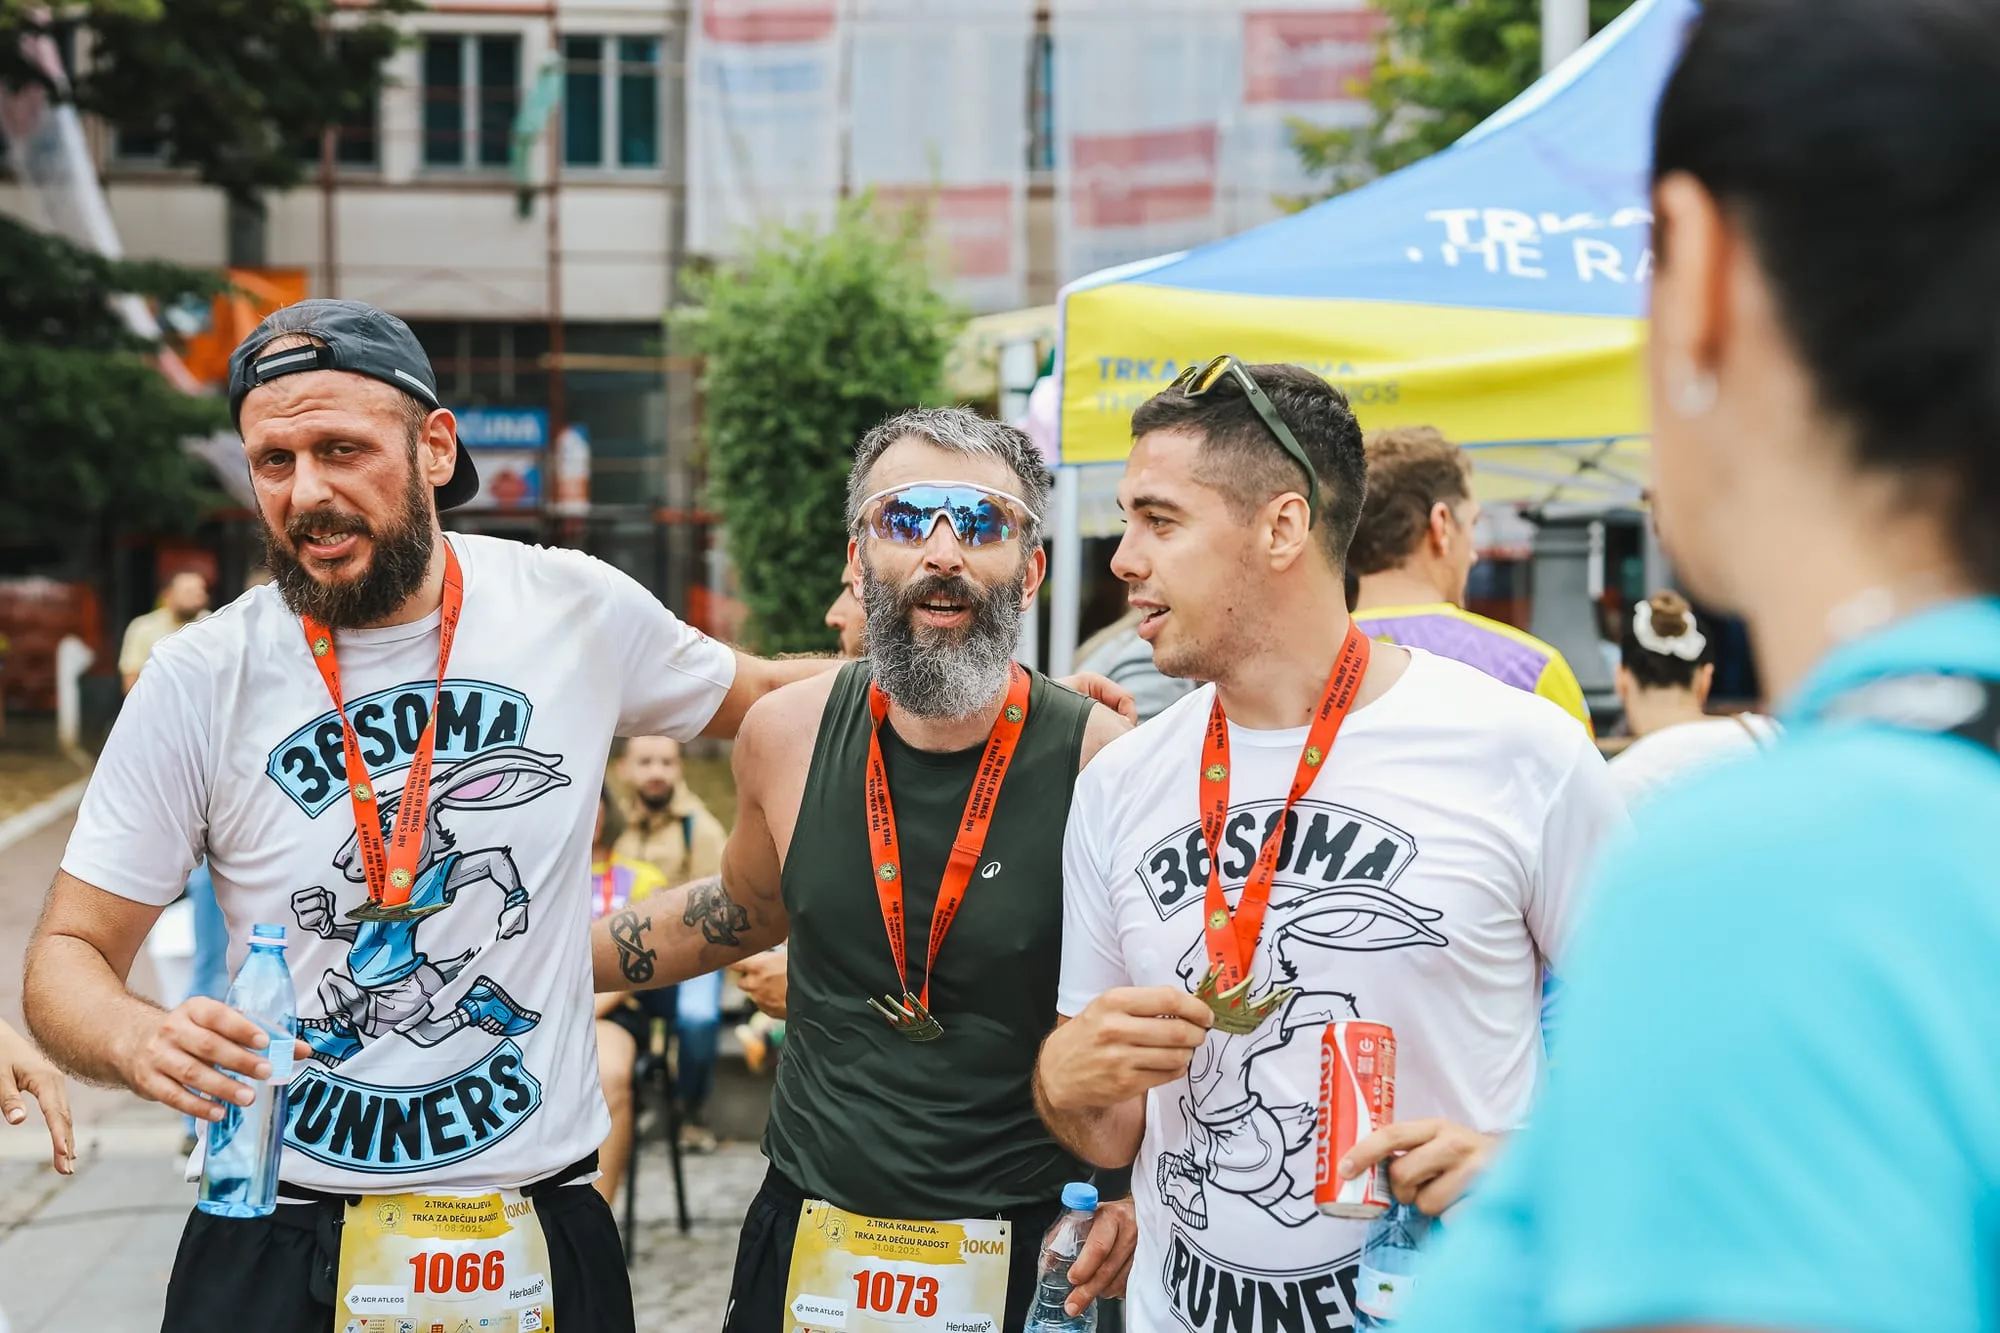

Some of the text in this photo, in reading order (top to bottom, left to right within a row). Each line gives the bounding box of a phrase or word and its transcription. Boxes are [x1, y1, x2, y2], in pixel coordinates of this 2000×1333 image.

[282, 691, 518, 803] 36SOMA
[1151, 808, 1398, 906] 36SOMA
[412, 1213, 434, 1222] TRKA
[436, 1214, 447, 1222] ZA
[450, 1212, 477, 1223] DEČIJU
[504, 1200, 532, 1219] 10KM
[867, 1219, 939, 1234] 2.TRKA KRALJEVA-
[854, 1231, 1005, 1255] TRKA ZA DEČIJU RADOST 10KM
[409, 1249, 505, 1294] 1066
[509, 1283, 541, 1300] Herbalife
[853, 1269, 939, 1318] 1073
[819, 1308, 844, 1317] ATLEOS
[946, 1321, 988, 1333] Herbalife
